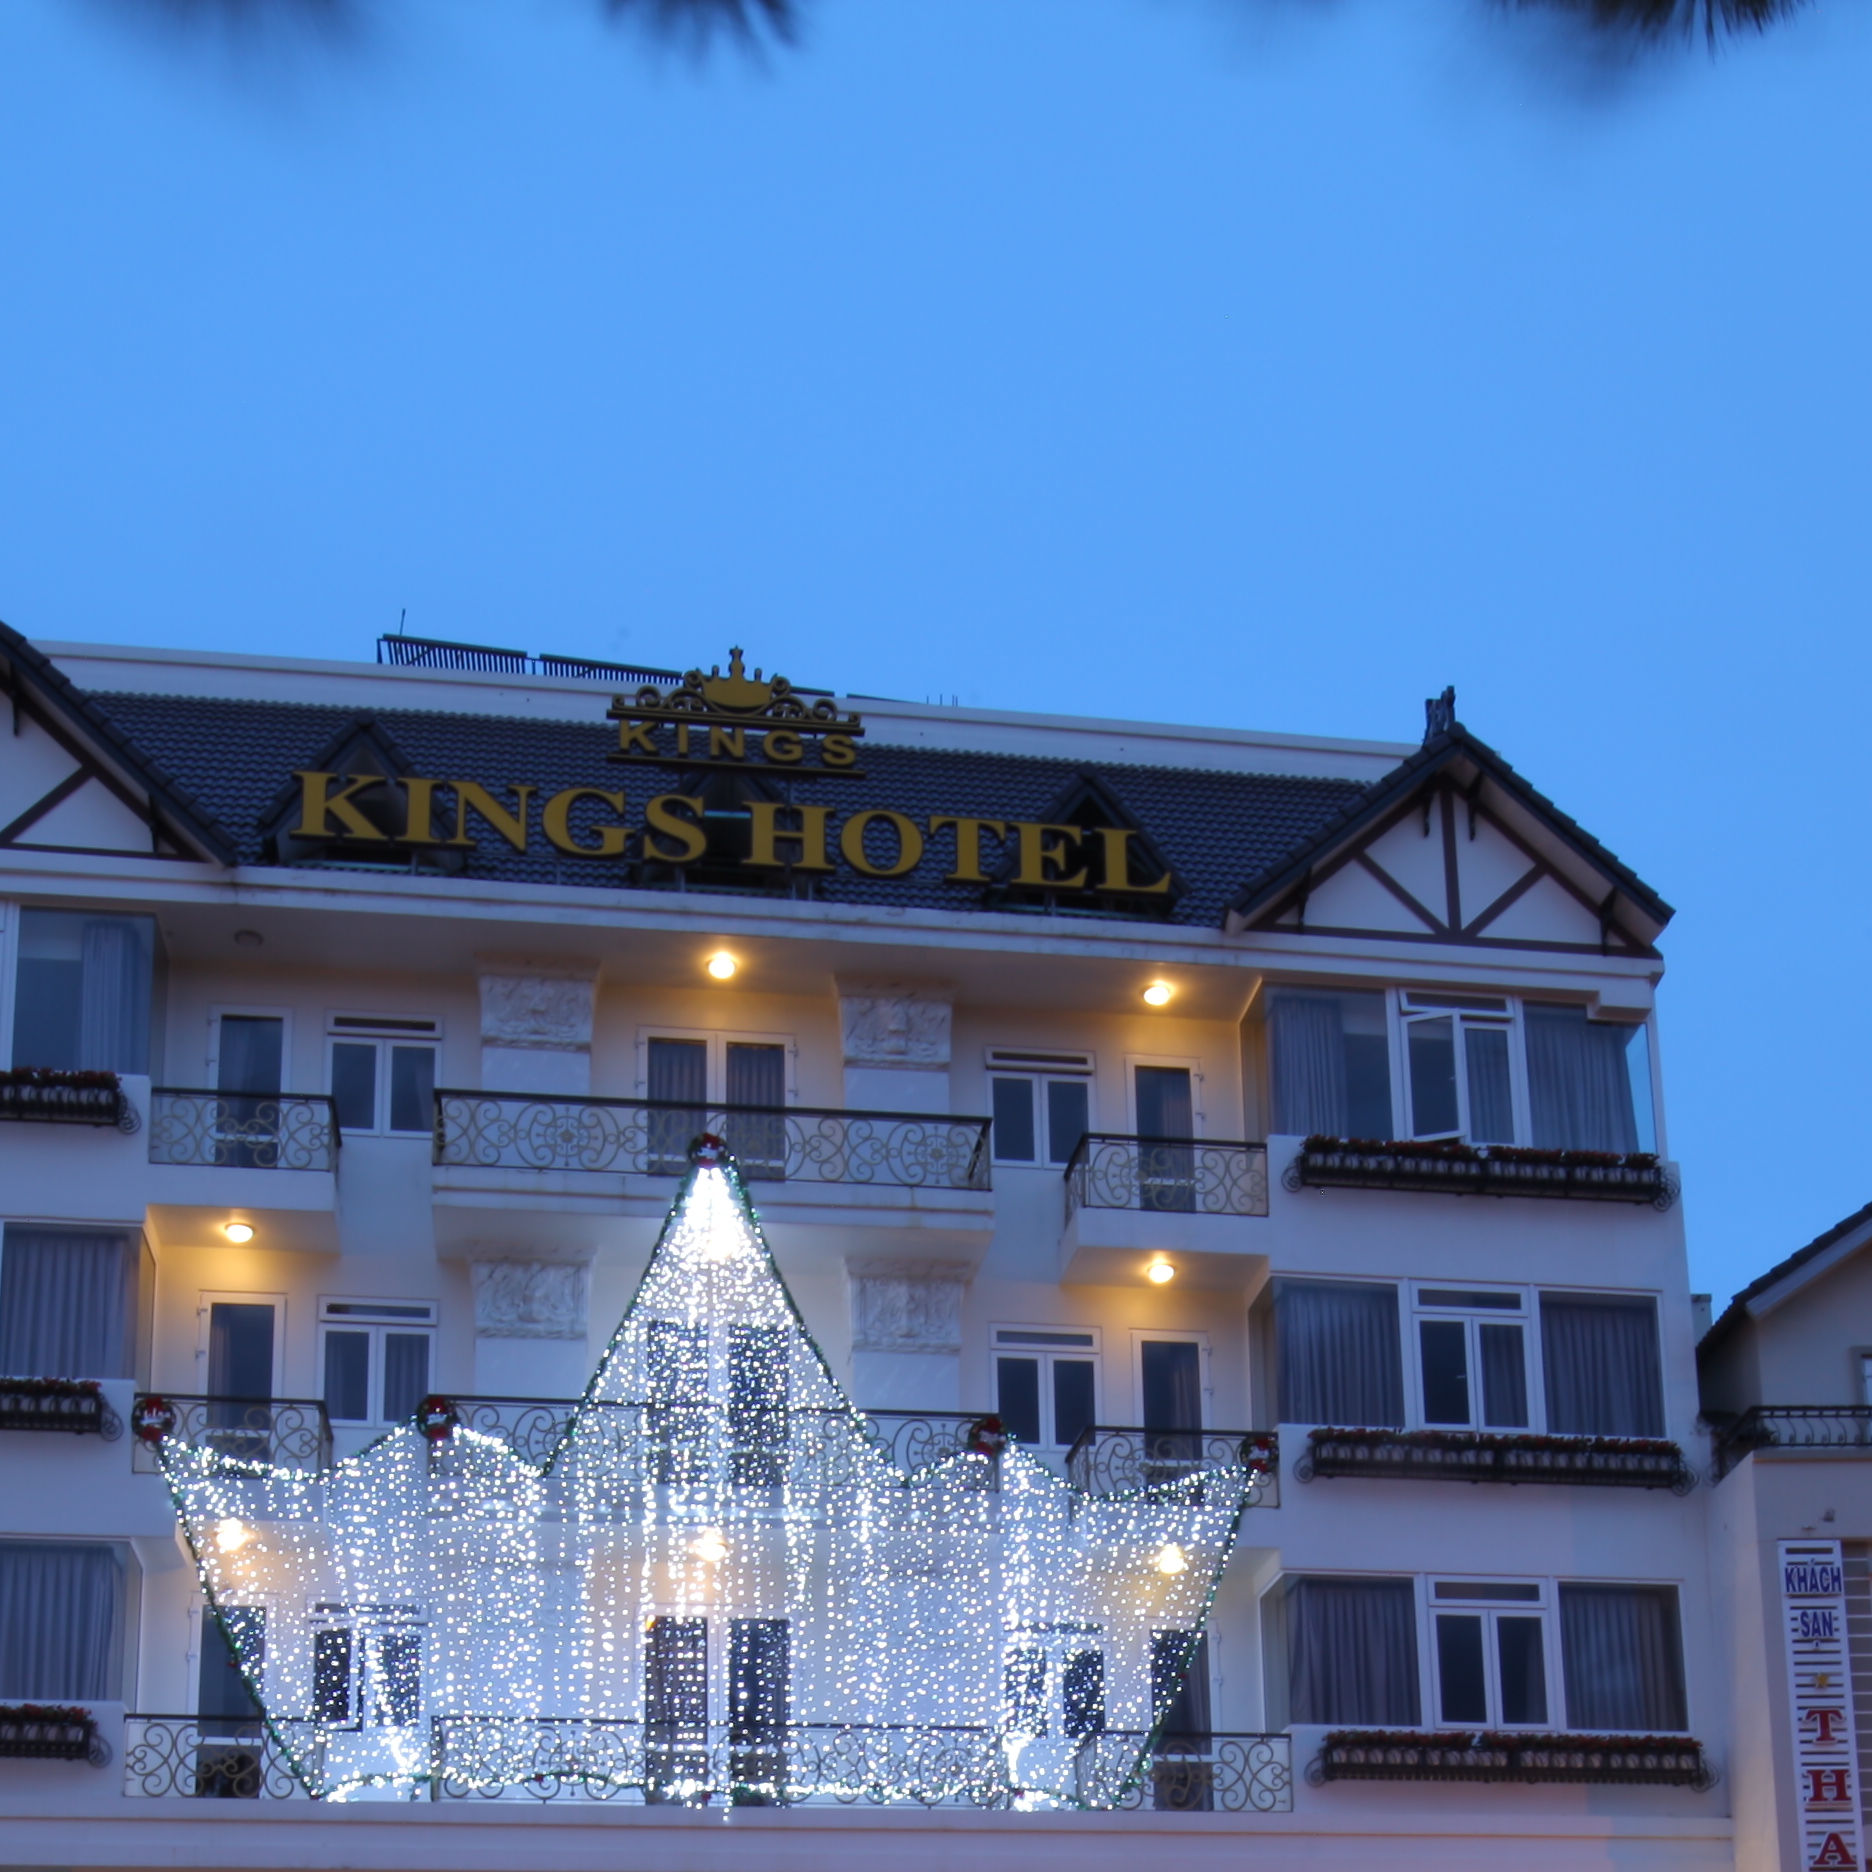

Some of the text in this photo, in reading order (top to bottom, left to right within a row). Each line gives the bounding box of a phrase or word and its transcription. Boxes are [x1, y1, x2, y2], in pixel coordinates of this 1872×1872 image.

[618, 718, 858, 767] KINGS
[290, 768, 1172, 895] KINGS HOTEL
[1784, 1558, 1842, 1593] KHÁCH
